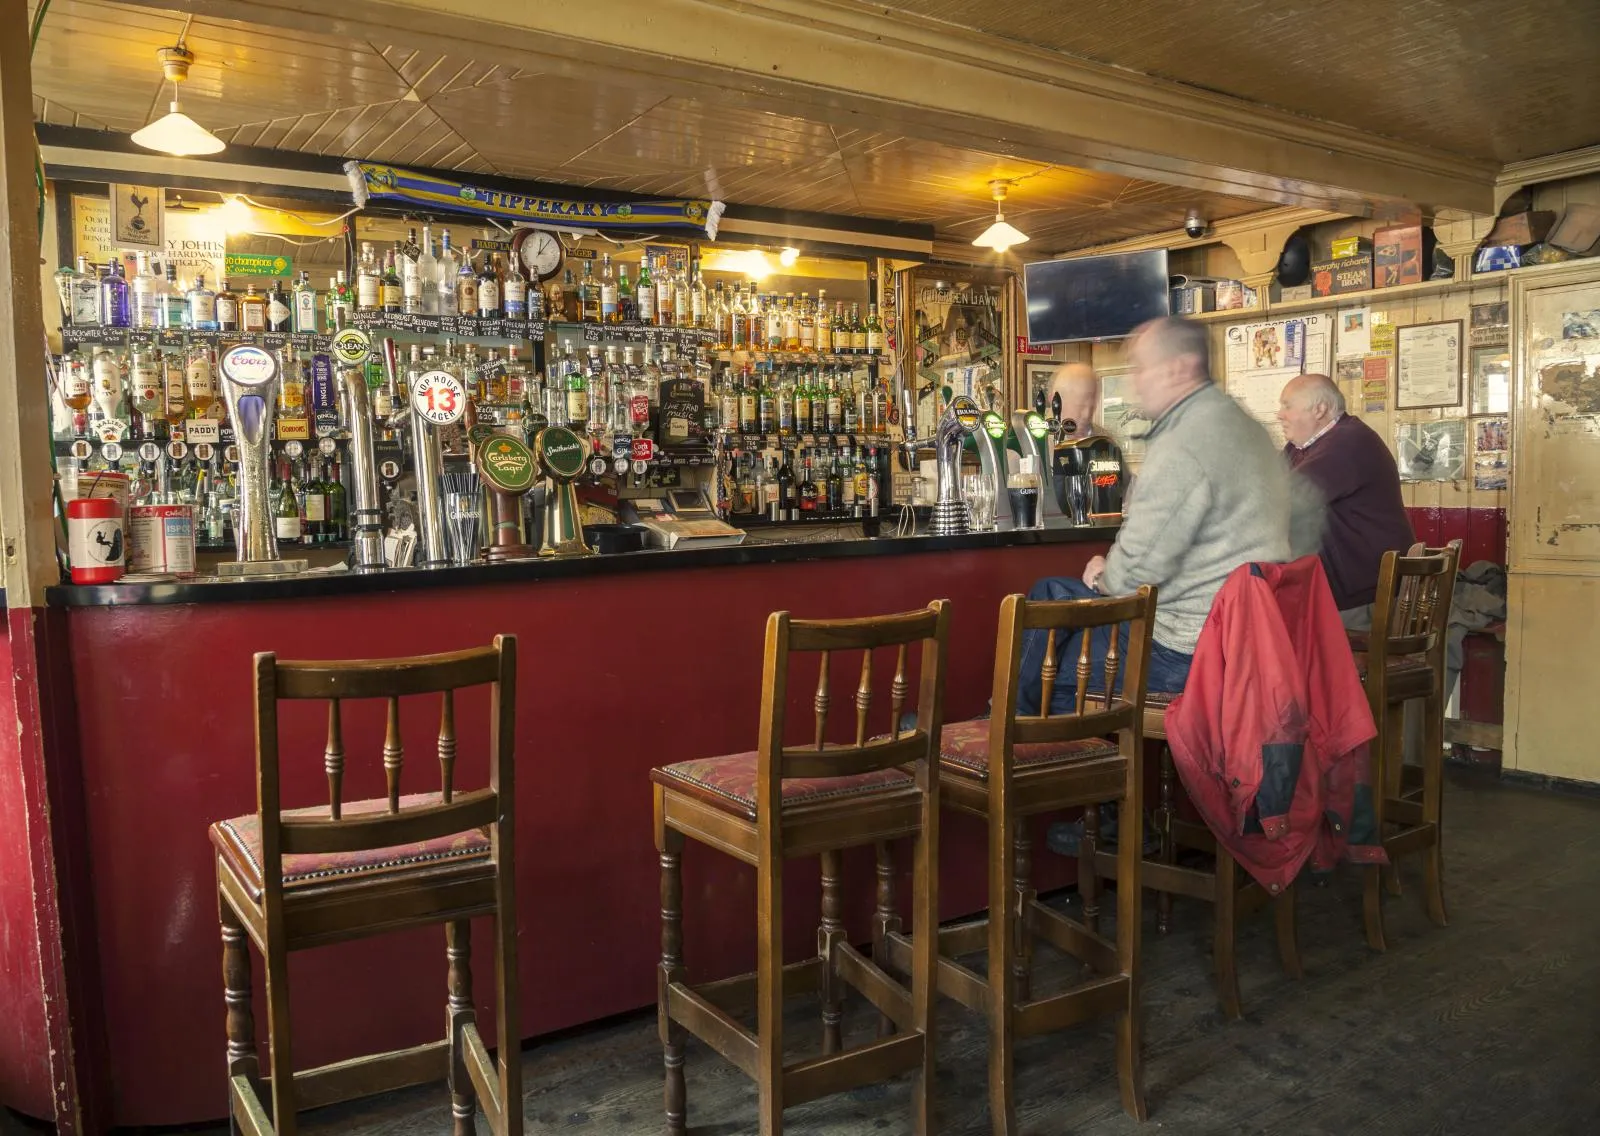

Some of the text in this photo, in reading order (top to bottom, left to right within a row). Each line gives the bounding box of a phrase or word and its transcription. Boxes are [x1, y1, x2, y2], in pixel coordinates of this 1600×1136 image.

[483, 190, 612, 216] TIPPERARY
[477, 241, 499, 249] HARP
[1341, 256, 1370, 268] richards
[1336, 270, 1367, 281] STEAM
[1342, 278, 1363, 287] IRON
[353, 312, 377, 320] DINGLE
[412, 316, 439, 328] BELVEDERE
[527, 322, 544, 330] HYDE
[63, 329, 102, 338] BLACKWATER
[231, 355, 268, 366] Coors
[417, 375, 461, 397] HOP HOUSE
[320, 382, 328, 407] DINGLE
[423, 387, 456, 412] 13
[426, 407, 456, 421] LAGER
[189, 426, 217, 434] PADDY
[546, 443, 580, 456] Smithwick's
[633, 442, 648, 451] Cork
[488, 452, 527, 465] Carlsberg
[498, 463, 525, 479] Lager
[1089, 459, 1120, 472] GUINNESS
[451, 511, 481, 520] GUINNESS
